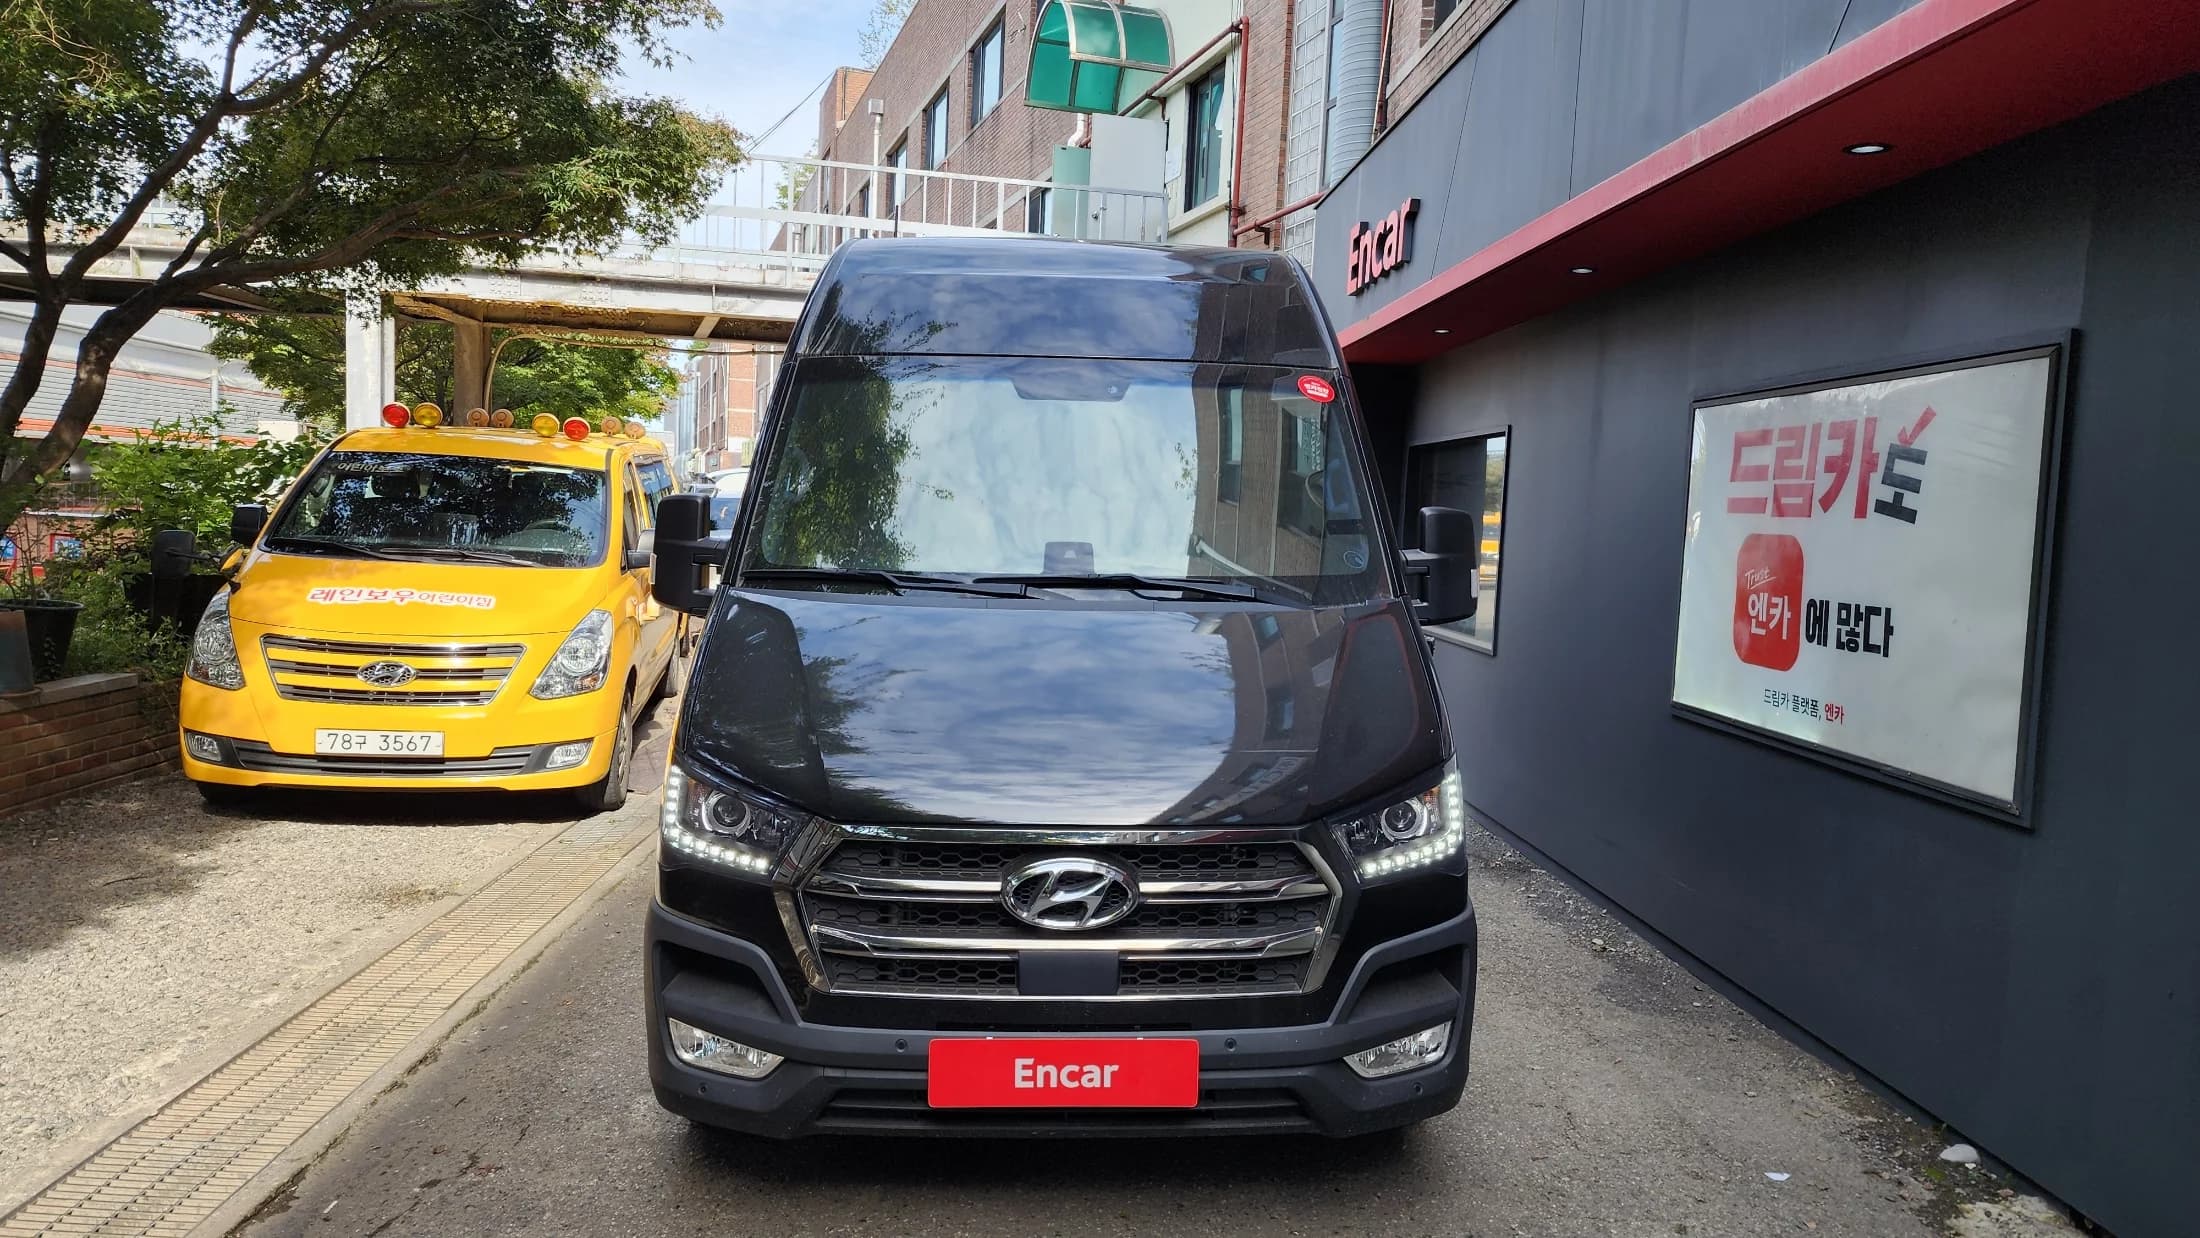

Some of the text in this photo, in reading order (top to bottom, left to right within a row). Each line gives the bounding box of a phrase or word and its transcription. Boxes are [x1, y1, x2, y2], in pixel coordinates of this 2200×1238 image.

[1346, 197, 1418, 296] Encar
[1727, 417, 1928, 525] 드림카도
[1745, 568, 1776, 590] Trust
[310, 588, 492, 608] 레인보우 어린이집
[1748, 592, 1791, 641] 엔카
[1835, 602, 1894, 658] 많다
[1763, 688, 1844, 726] 드림카 플랫폼, 엔카
[327, 733, 432, 752] 78구 3567
[1014, 1057, 1120, 1088] Encar
